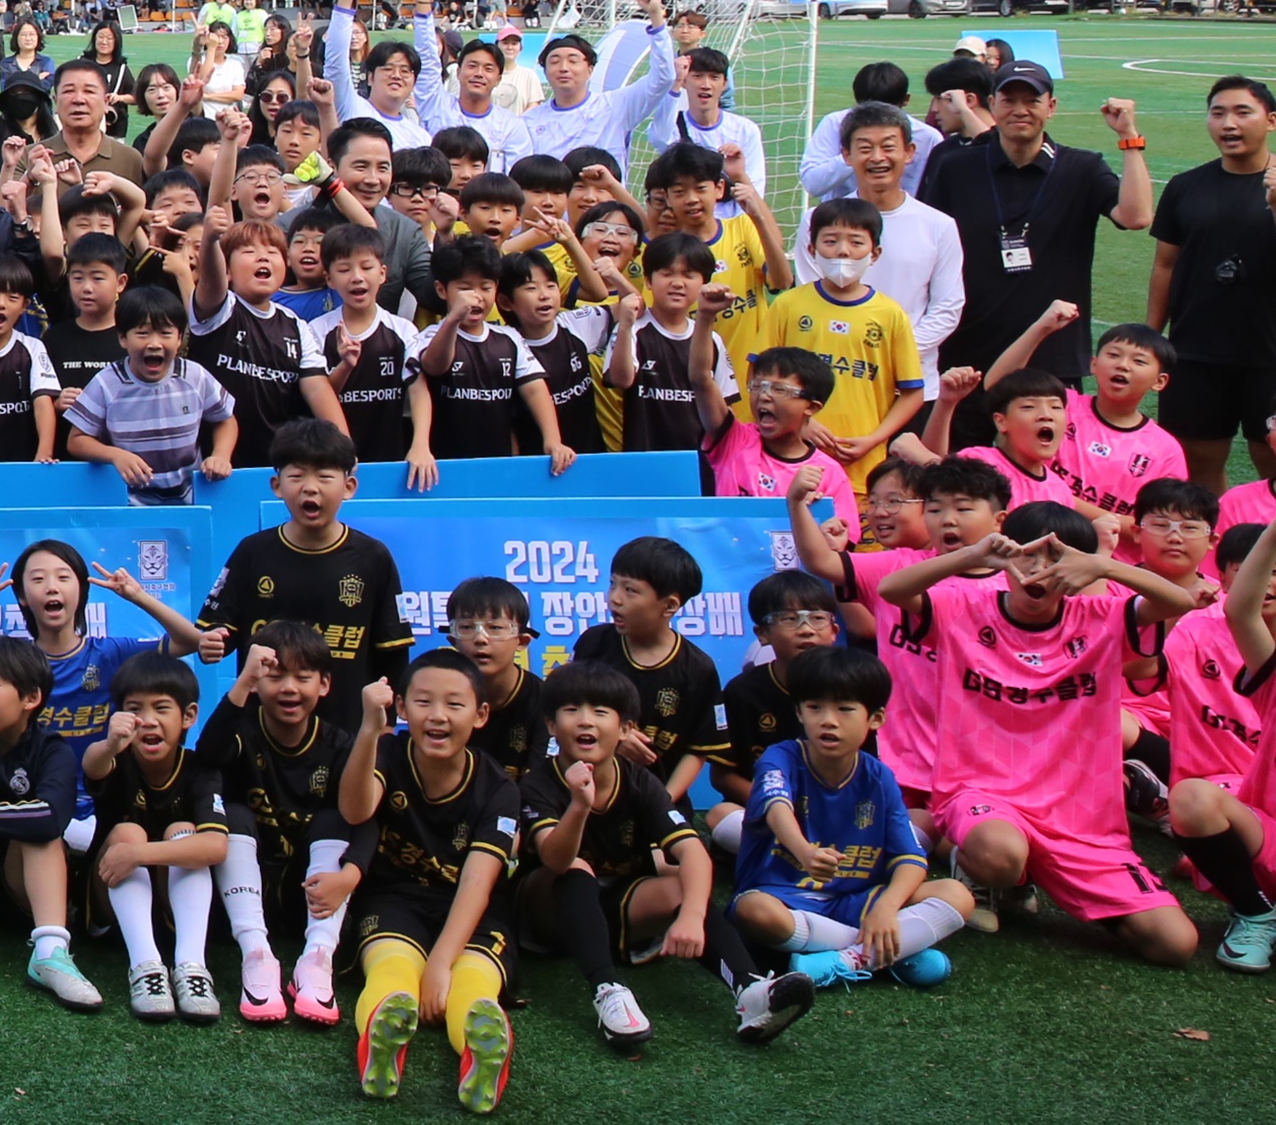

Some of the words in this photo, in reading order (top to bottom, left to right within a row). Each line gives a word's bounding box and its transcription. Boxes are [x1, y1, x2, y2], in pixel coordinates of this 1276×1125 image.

[285, 342, 298, 359] 14
[63, 361, 81, 369] THE
[380, 361, 395, 377] 20
[503, 541, 599, 584] 2024
